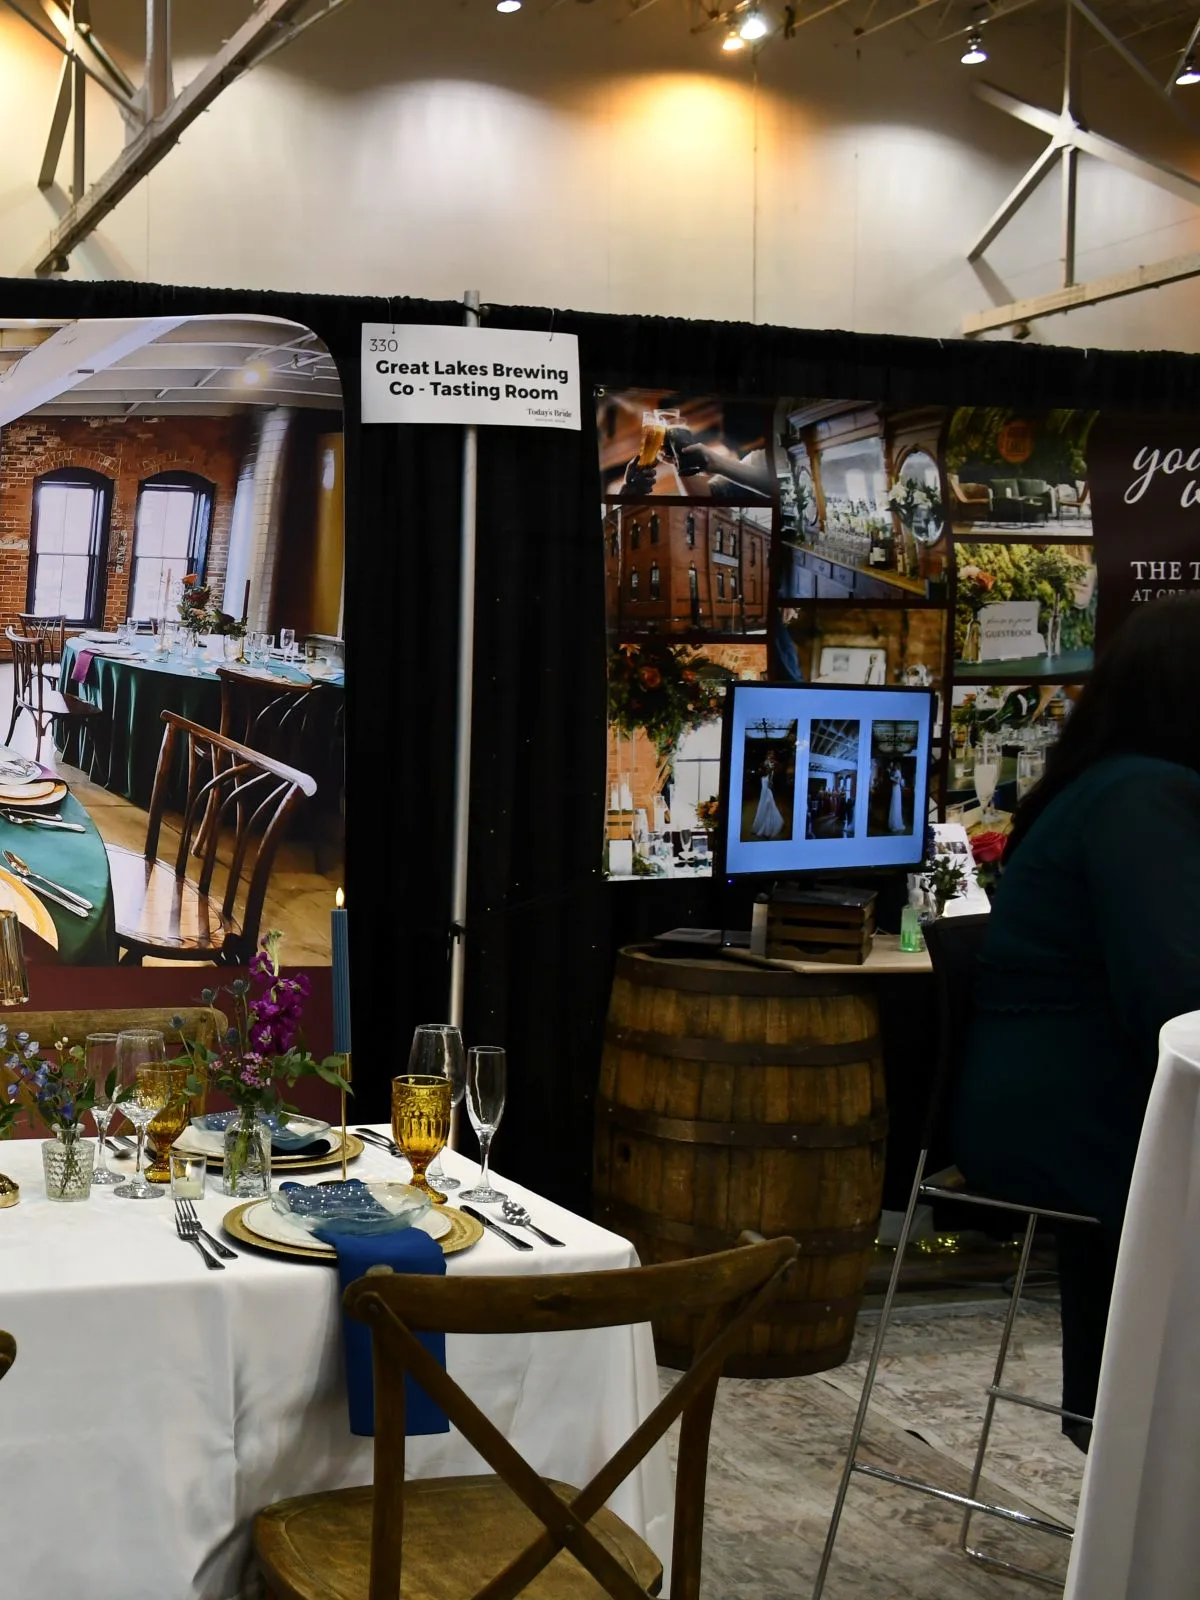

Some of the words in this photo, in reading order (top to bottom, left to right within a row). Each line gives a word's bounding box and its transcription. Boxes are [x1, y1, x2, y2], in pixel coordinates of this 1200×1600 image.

[369, 338, 399, 353] 330
[375, 359, 430, 375] Great
[434, 360, 489, 376] Lakes
[492, 362, 569, 384] Brewing
[388, 381, 415, 396] Co
[429, 381, 500, 401] Tasting
[505, 384, 559, 401] Room
[1130, 561, 1183, 580] THE
[1131, 588, 1153, 602] AT
